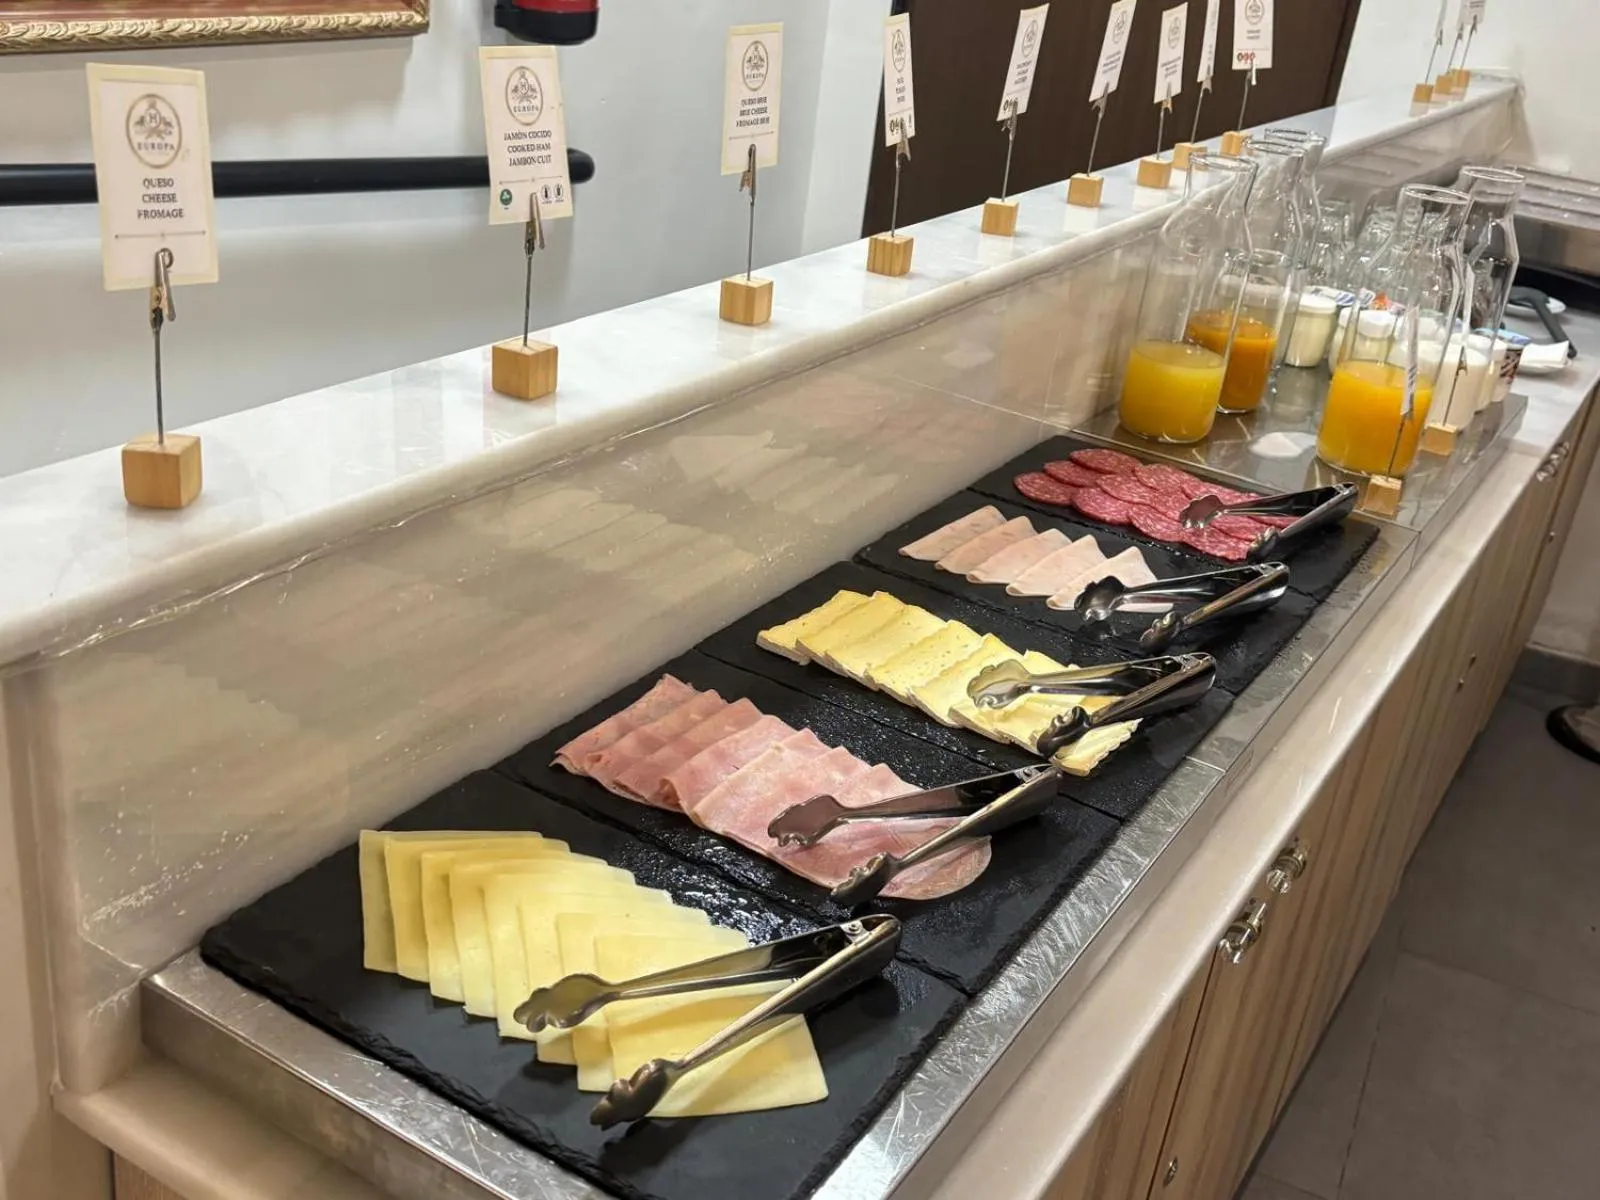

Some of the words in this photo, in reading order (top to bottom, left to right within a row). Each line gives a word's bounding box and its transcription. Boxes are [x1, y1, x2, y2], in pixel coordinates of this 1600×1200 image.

[528, 130, 552, 139] COCIDO
[507, 144, 535, 153] COOKED
[536, 143, 551, 151] HAM
[509, 156, 536, 166] JAMBON
[537, 155, 551, 164] CUIT
[143, 178, 174, 189] QUESO
[142, 193, 177, 203] CHEESE
[137, 208, 184, 219] FROMAGE
